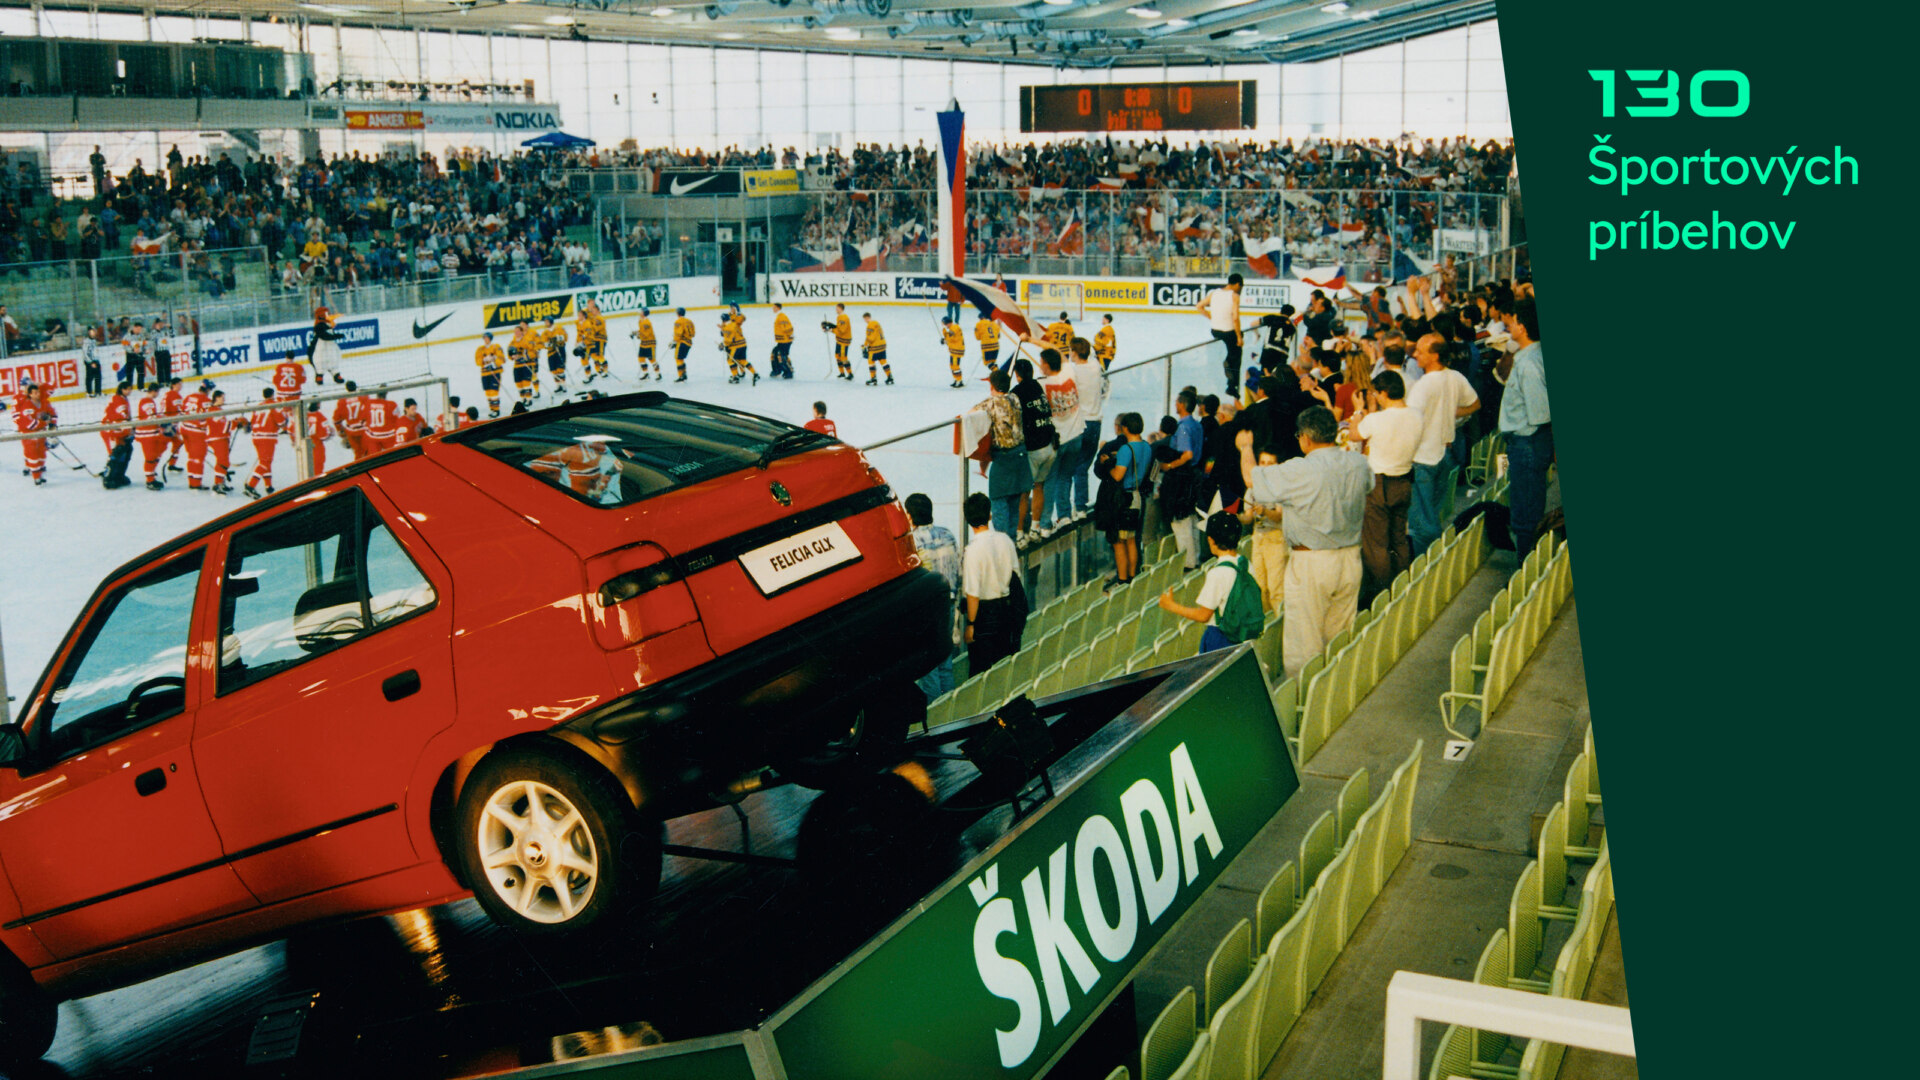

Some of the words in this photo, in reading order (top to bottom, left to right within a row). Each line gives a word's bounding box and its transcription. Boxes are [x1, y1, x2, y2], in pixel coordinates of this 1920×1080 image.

[1078, 88, 1092, 116] 0
[1177, 86, 1193, 115] 0
[368, 113, 405, 128] ANKER
[495, 112, 557, 129] NOKIA
[780, 280, 890, 298] WARSTEINER
[595, 289, 648, 312] ŠKODA
[499, 300, 561, 323] ruhrgas
[262, 334, 303, 354] WODKA
[279, 371, 297, 388] 26
[346, 402, 361, 421] 17
[370, 409, 386, 428] 10
[769, 544, 815, 573] FELICIA
[811, 536, 836, 555] GLX
[1452, 745, 1466, 758] 7
[967, 741, 1225, 1069] ŠKODA
